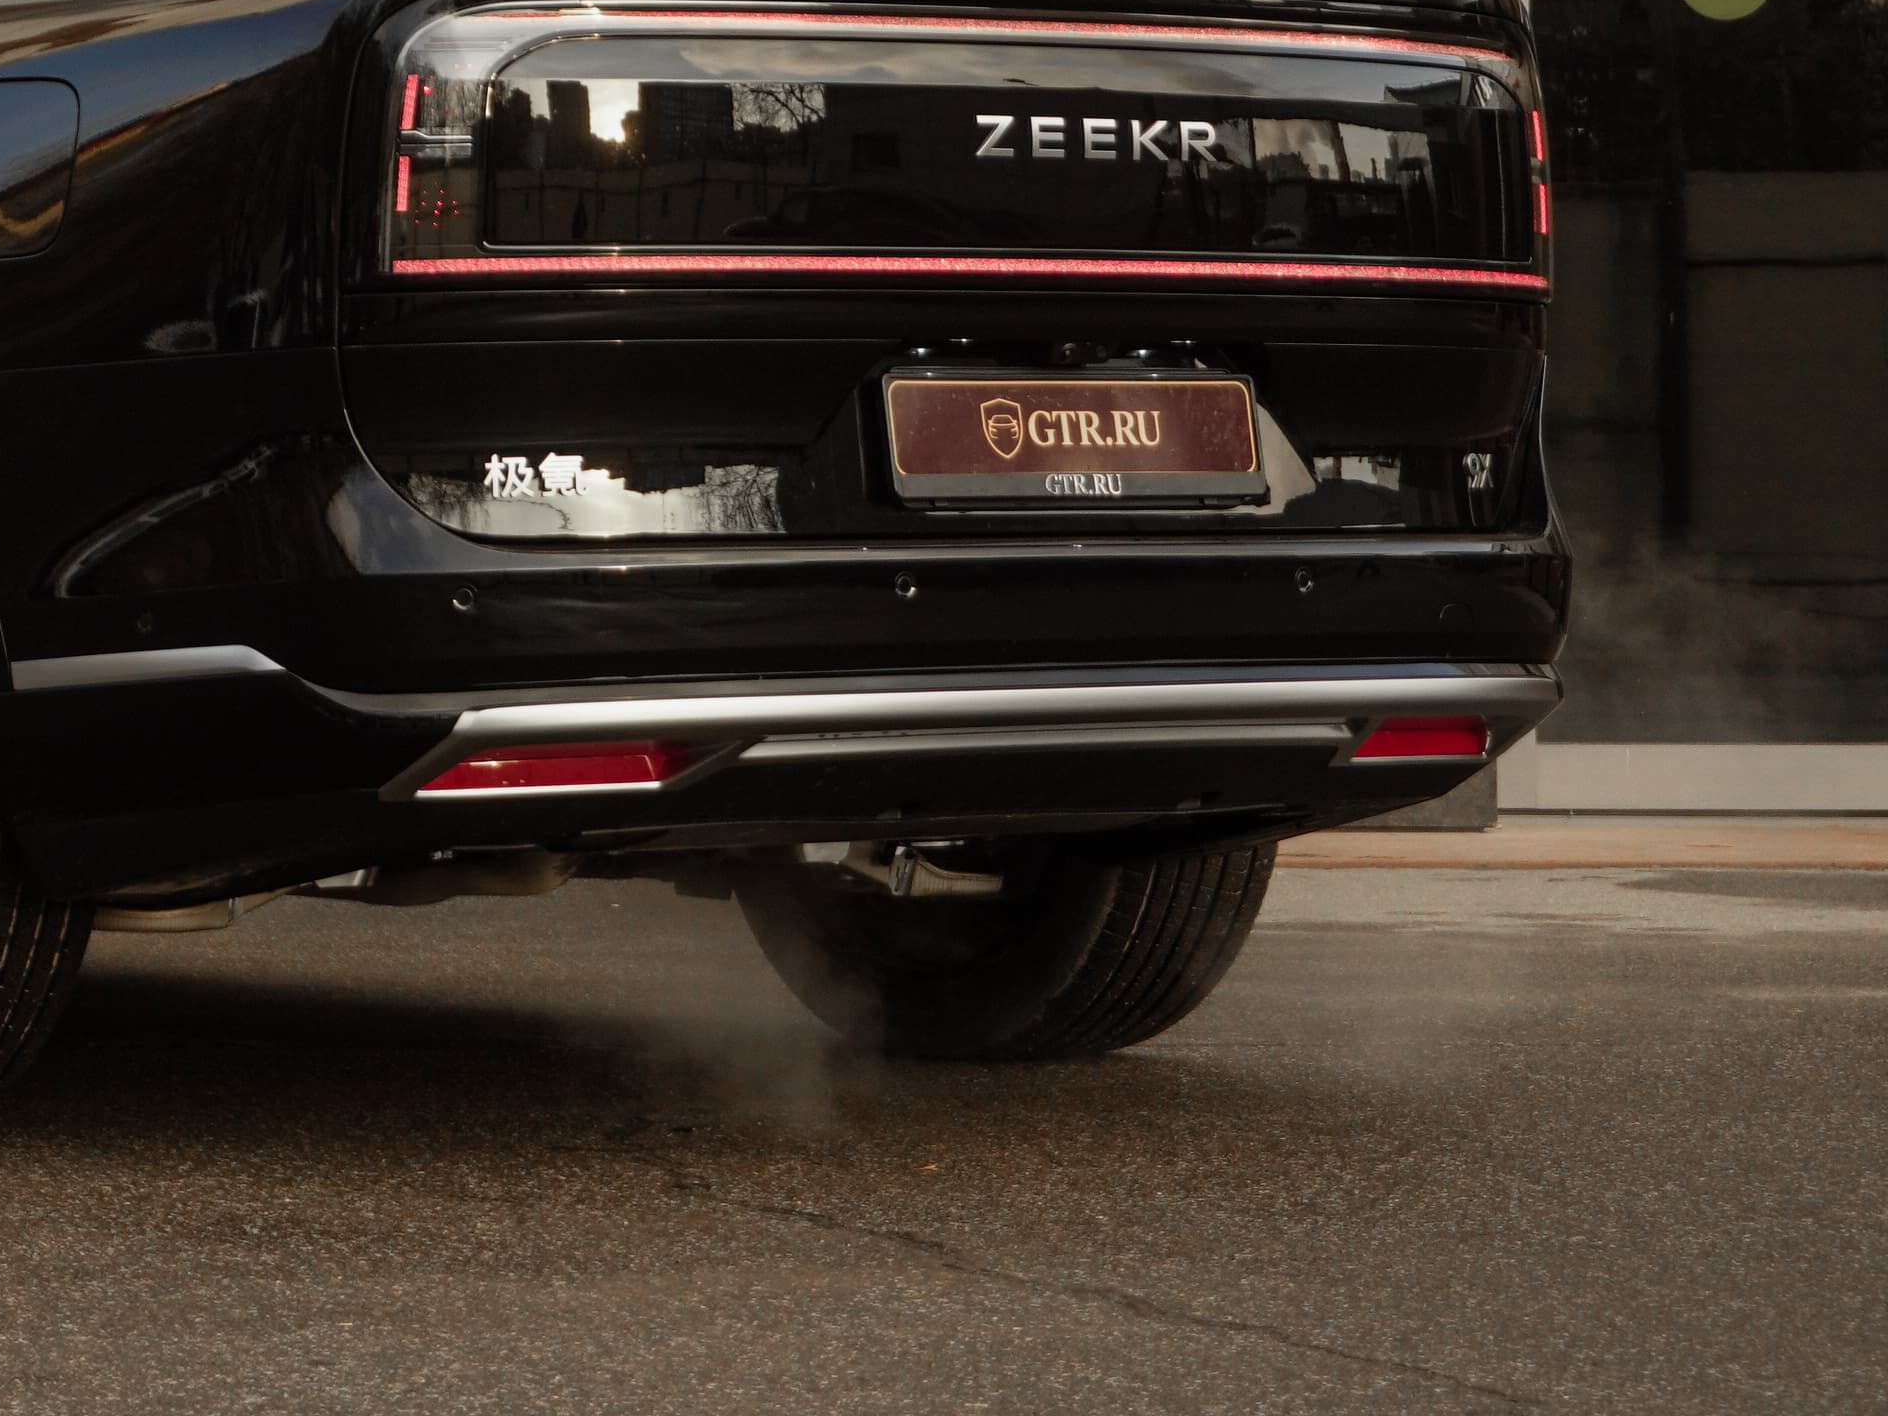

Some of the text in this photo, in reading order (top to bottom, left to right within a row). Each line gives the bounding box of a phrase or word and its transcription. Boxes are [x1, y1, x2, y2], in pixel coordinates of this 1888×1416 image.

[975, 114, 1218, 162] ZEEKR
[1027, 409, 1161, 448] GTR.RU
[483, 451, 590, 499] 极氪
[1044, 472, 1123, 496] GTR.RU
